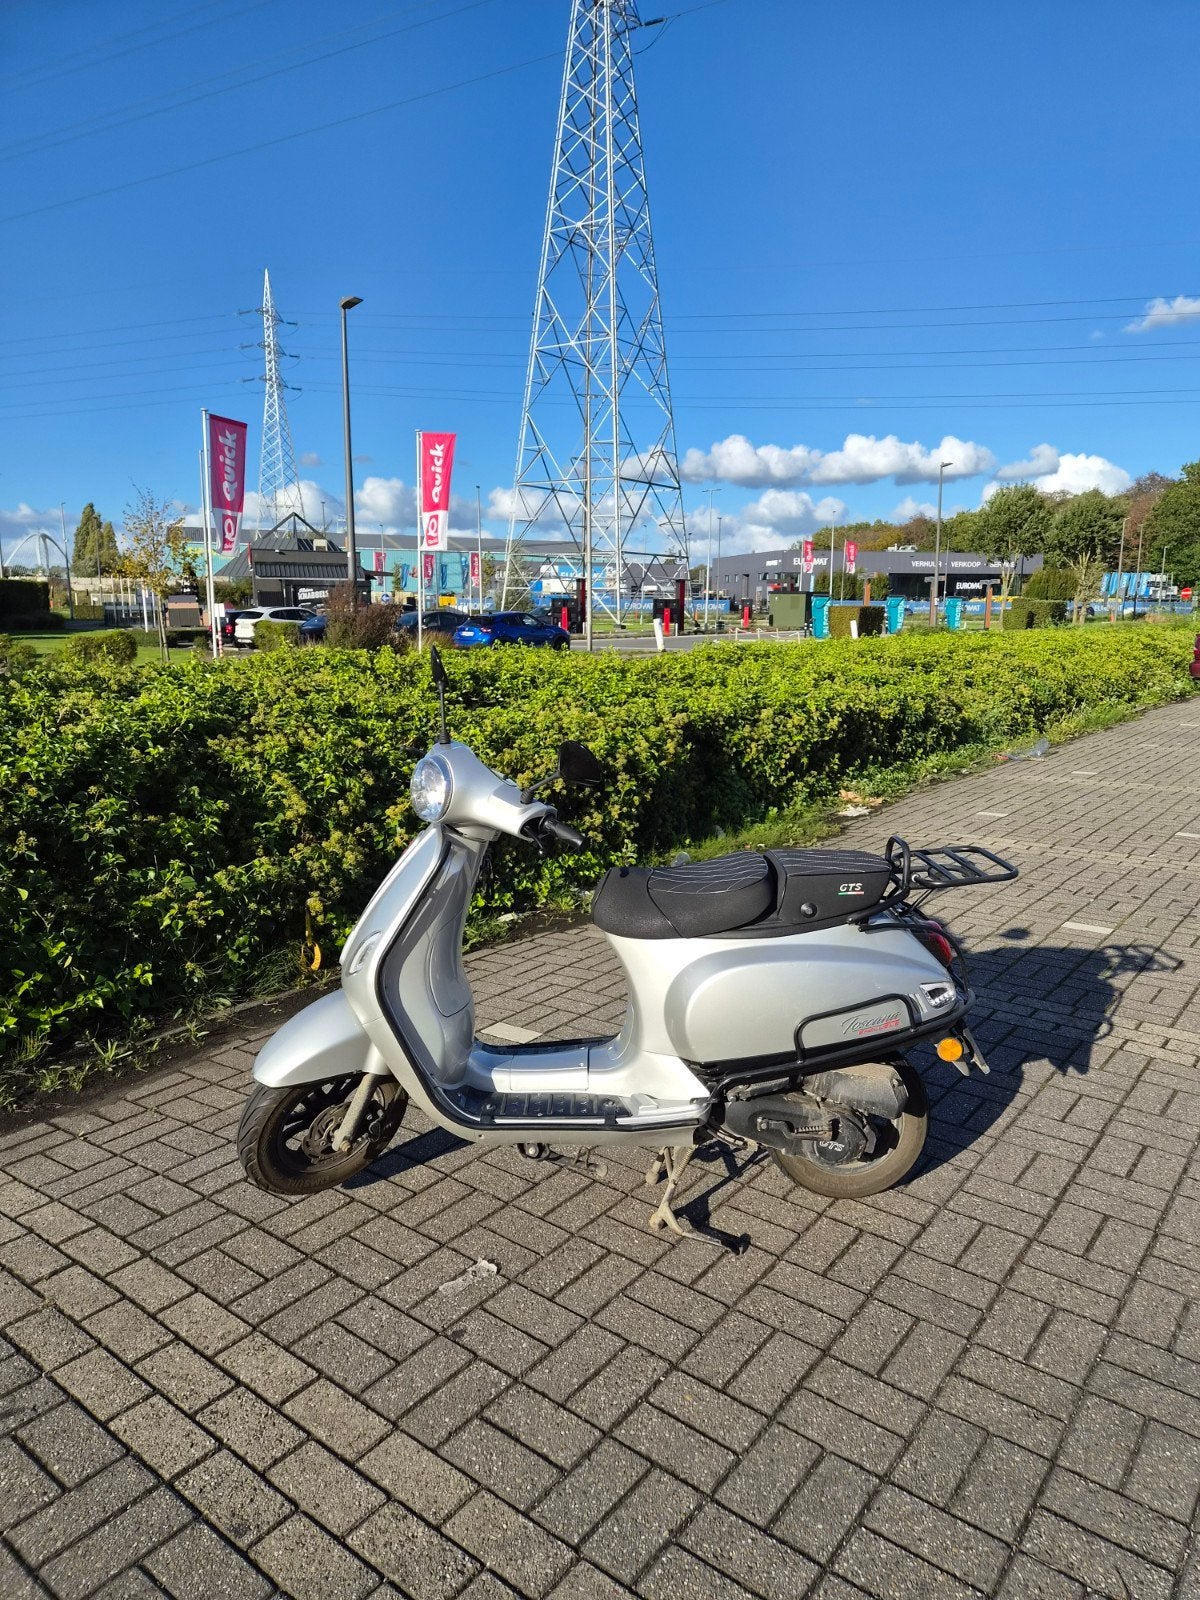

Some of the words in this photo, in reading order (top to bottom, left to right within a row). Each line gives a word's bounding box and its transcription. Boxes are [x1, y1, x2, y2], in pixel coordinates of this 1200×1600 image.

[219, 429, 238, 502] Quick
[429, 443, 445, 503] Quick
[839, 882, 863, 892] GTS
